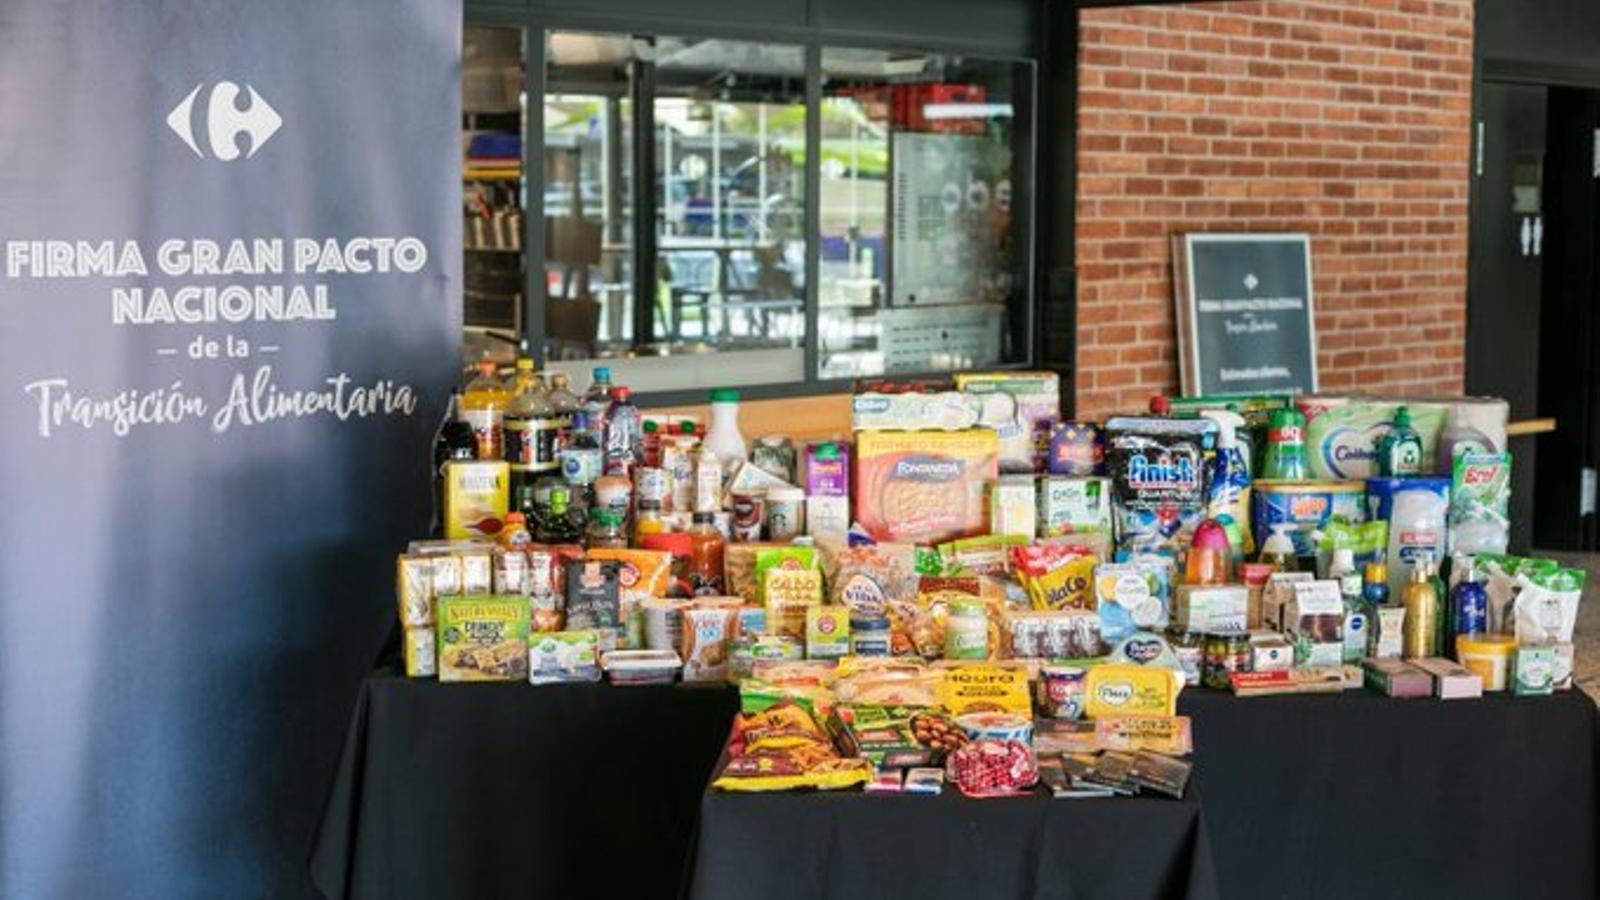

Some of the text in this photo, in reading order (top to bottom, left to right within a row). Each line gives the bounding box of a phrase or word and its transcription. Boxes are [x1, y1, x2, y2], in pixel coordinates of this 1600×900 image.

[6, 237, 428, 278] FIRMA GRAN PACTO
[112, 284, 336, 324] NACIONAL
[188, 335, 249, 359] de la
[25, 365, 417, 437] Transición Alimentaria
[1129, 455, 1195, 485] finish
